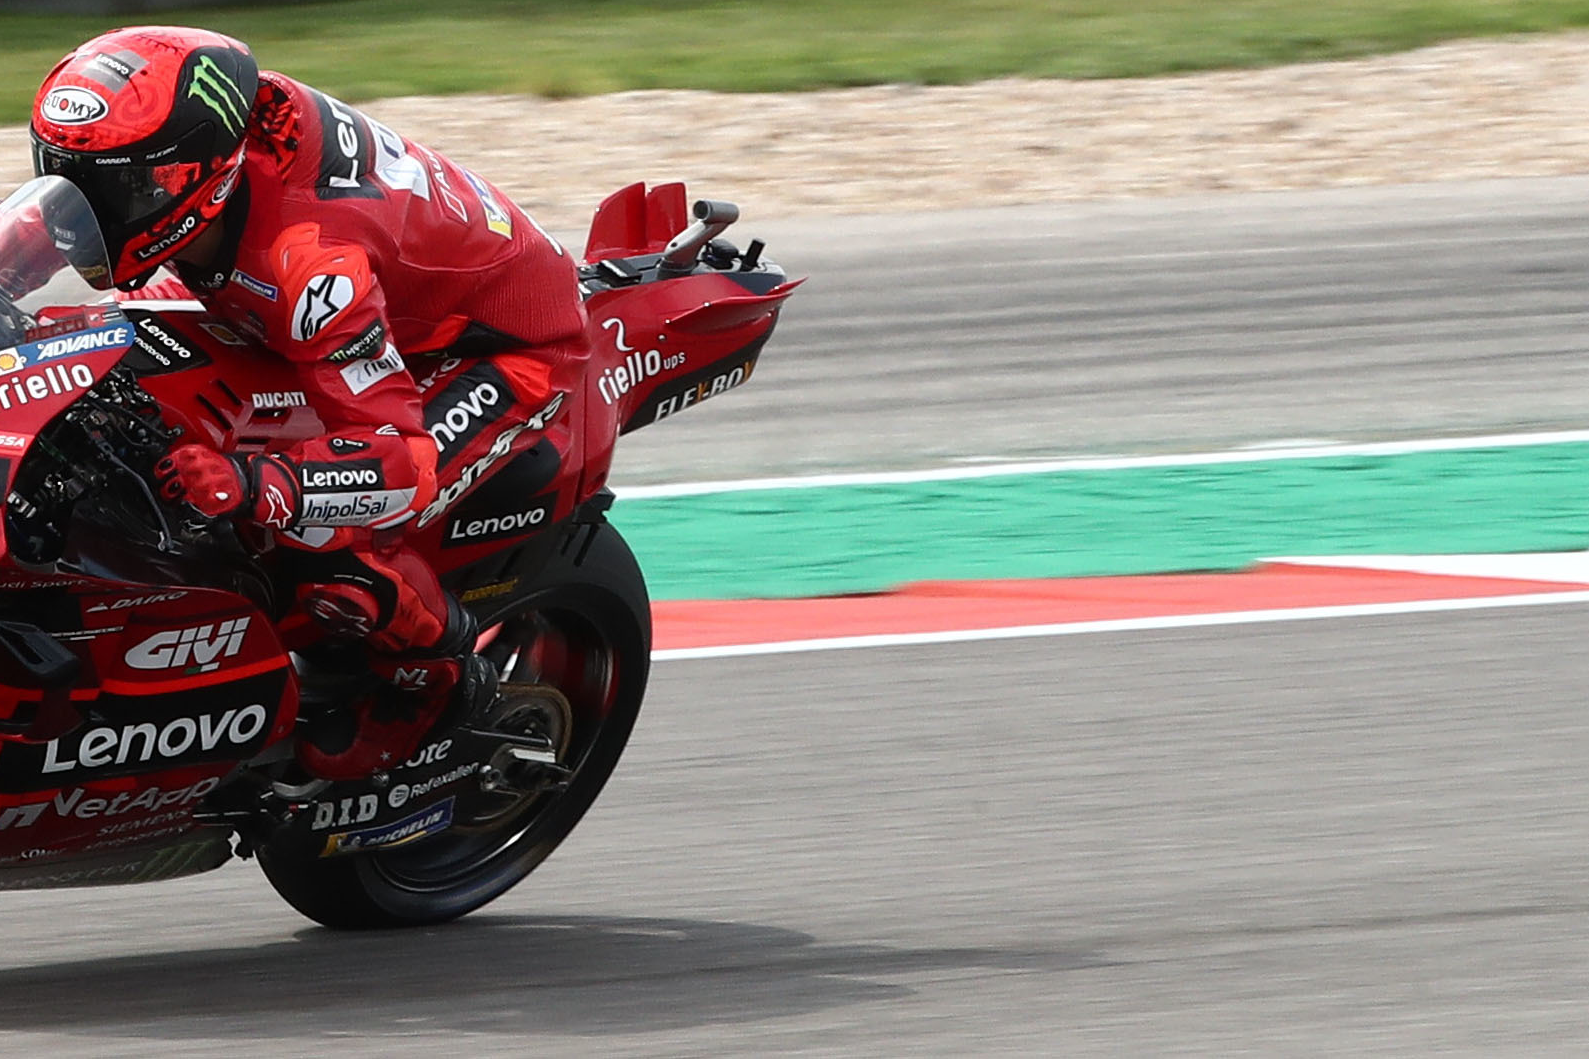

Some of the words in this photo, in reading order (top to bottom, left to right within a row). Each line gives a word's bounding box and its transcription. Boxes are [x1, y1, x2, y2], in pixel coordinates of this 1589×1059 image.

[45, 92, 99, 119] SUOMY
[138, 216, 196, 259] Lenovo
[37, 327, 128, 361] ADVANCE
[134, 336, 171, 366] motorola
[138, 317, 192, 359] Lenovo
[598, 350, 661, 405] riello
[663, 352, 686, 370] ups
[252, 391, 306, 408] DUCATI
[427, 382, 499, 453] novo
[302, 468, 378, 487] Lenovo
[450, 508, 545, 540] Lenovo
[124, 616, 251, 670] GIVI
[41, 704, 266, 774] Lenovo
[312, 794, 379, 830] D.I.D
